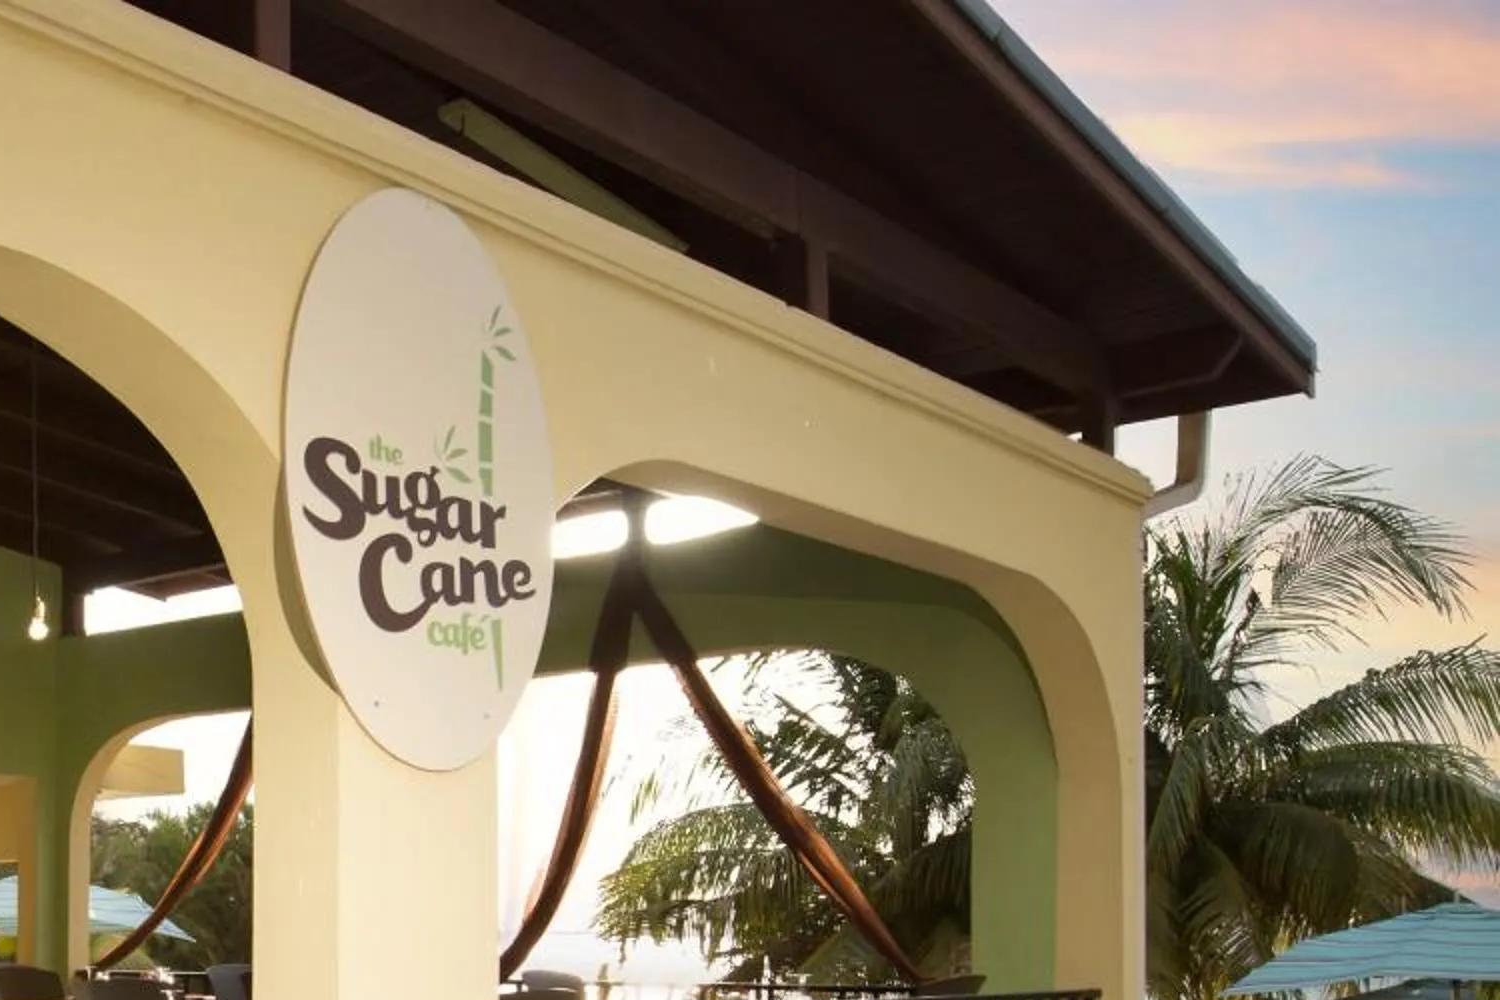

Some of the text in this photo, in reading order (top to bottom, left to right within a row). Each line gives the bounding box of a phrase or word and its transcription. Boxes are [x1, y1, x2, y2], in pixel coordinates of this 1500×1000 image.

[369, 433, 403, 466] the
[303, 437, 506, 548] Sugar
[358, 533, 536, 633] Cane
[428, 612, 491, 655] café
